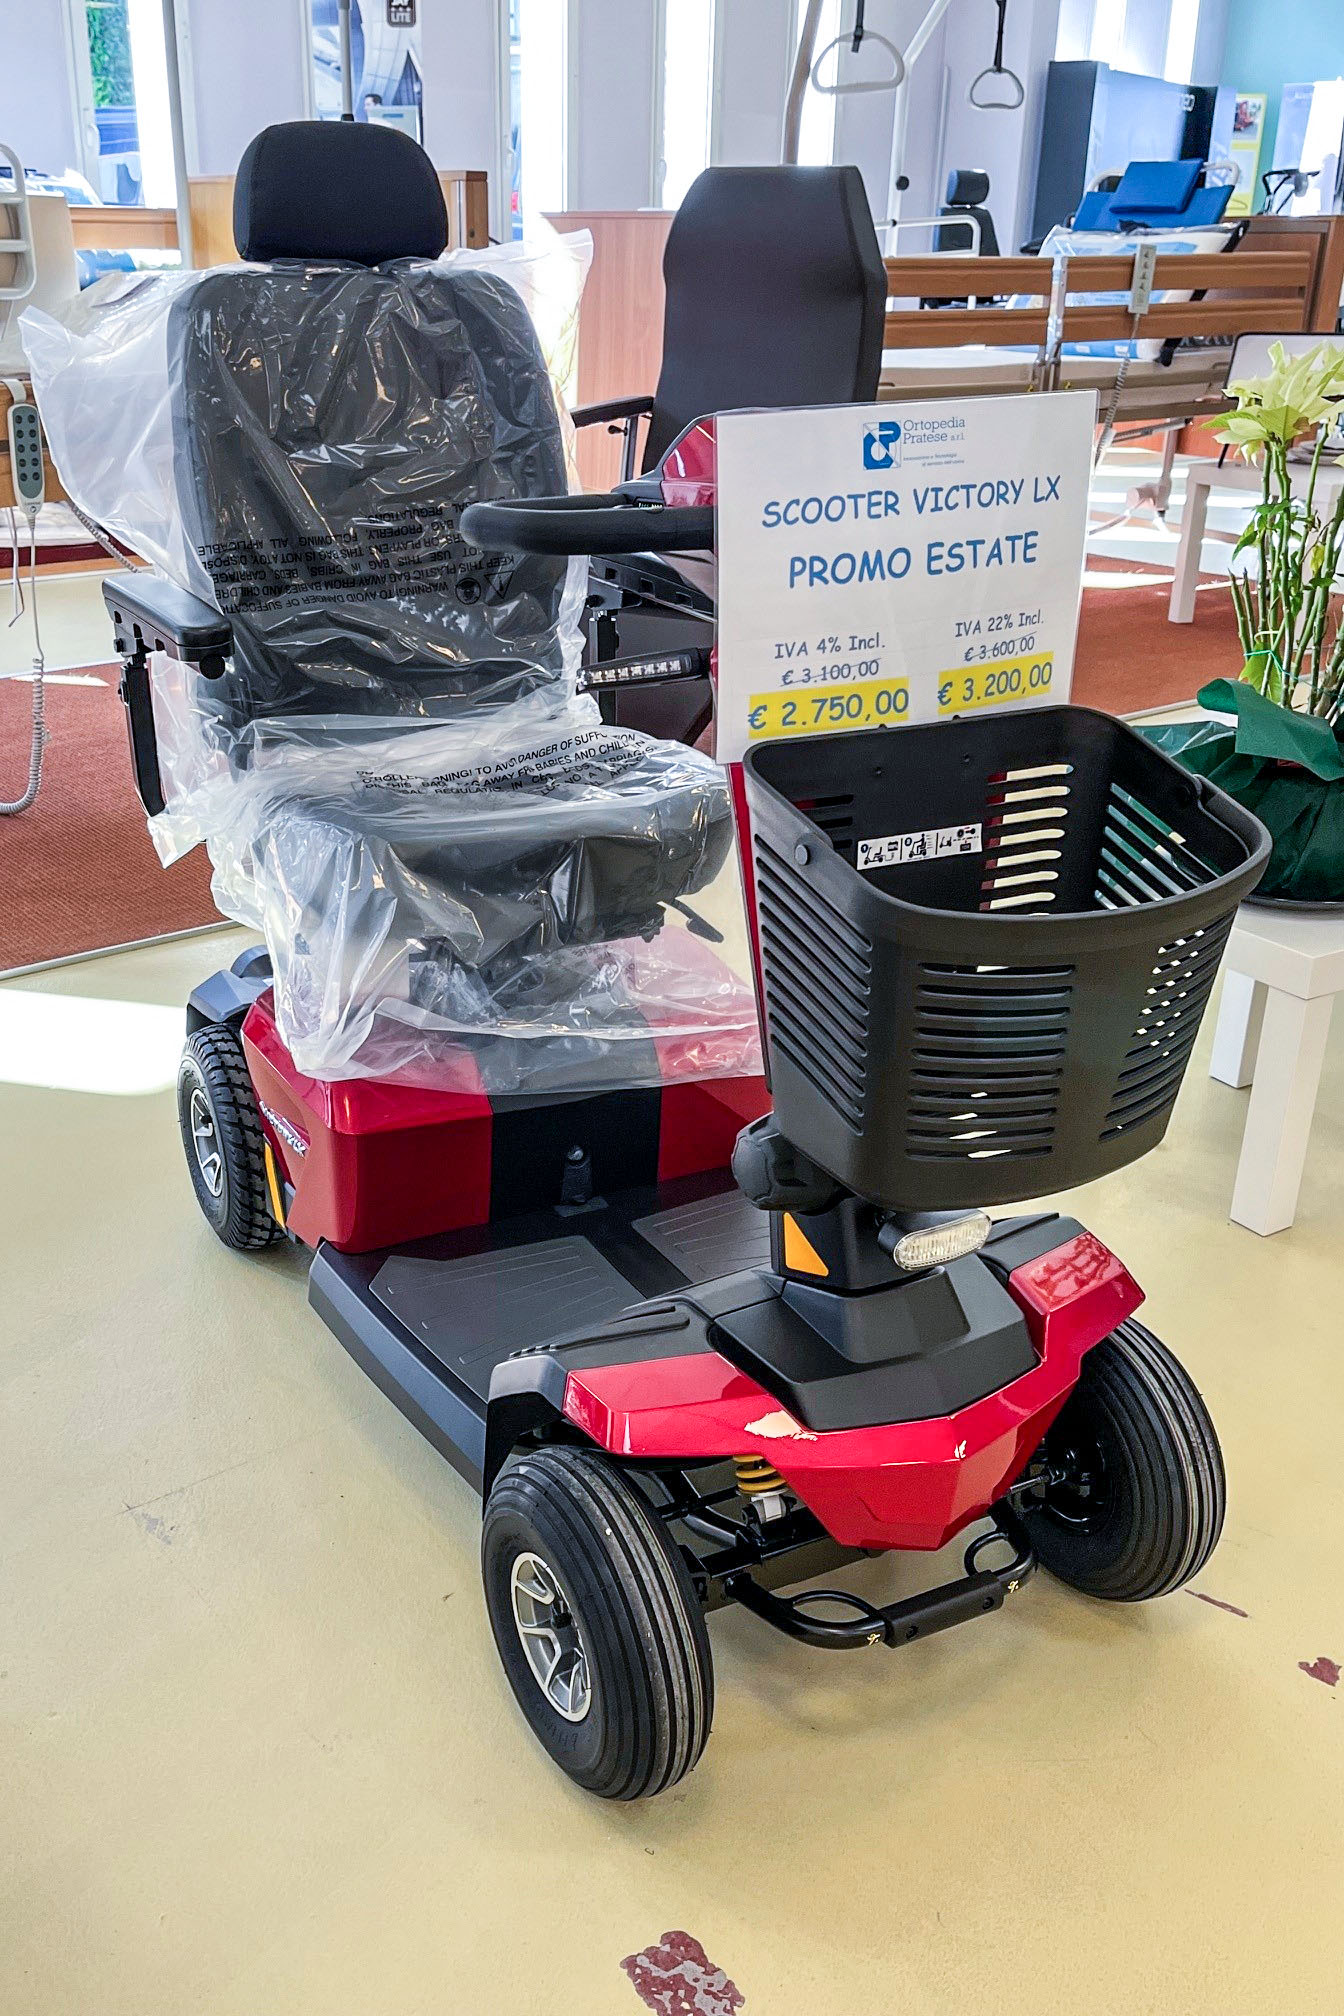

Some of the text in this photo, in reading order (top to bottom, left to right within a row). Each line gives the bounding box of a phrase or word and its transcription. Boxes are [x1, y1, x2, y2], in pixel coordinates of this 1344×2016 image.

[903, 417, 966, 433] Ortopedia
[903, 432, 948, 444] Pratese
[761, 474, 1062, 529] SCOOTER VICTORY LX
[269, 538, 289, 549] ALL
[280, 552, 303, 563] NOT
[305, 551, 316, 562] IS
[397, 555, 422, 567] THIS
[430, 550, 451, 561] USE
[487, 555, 515, 569] KEEP
[788, 530, 1039, 589] PROMO ESTATE
[368, 558, 390, 570] BAG
[458, 561, 484, 573] THIS
[358, 574, 387, 587] AWAY
[388, 572, 411, 583] BAG
[262, 584, 284, 596] AND
[324, 578, 356, 591] FROM
[285, 599, 300, 608] OF
[301, 594, 344, 607] DANGER
[955, 609, 1045, 638] IVA 22% Incl.
[774, 632, 887, 660] IVA 4% Incl.
[963, 635, 1036, 663] € 3.600,00
[781, 659, 880, 685] € 3.100,00
[937, 661, 1053, 706] € 3.200,00
[747, 687, 910, 730] € 2.750,00
[475, 766, 492, 775] TO
[518, 744, 558, 763] DANGER
[560, 739, 574, 751] OF
[535, 756, 572, 772] BABIES
[574, 747, 597, 762] AND
